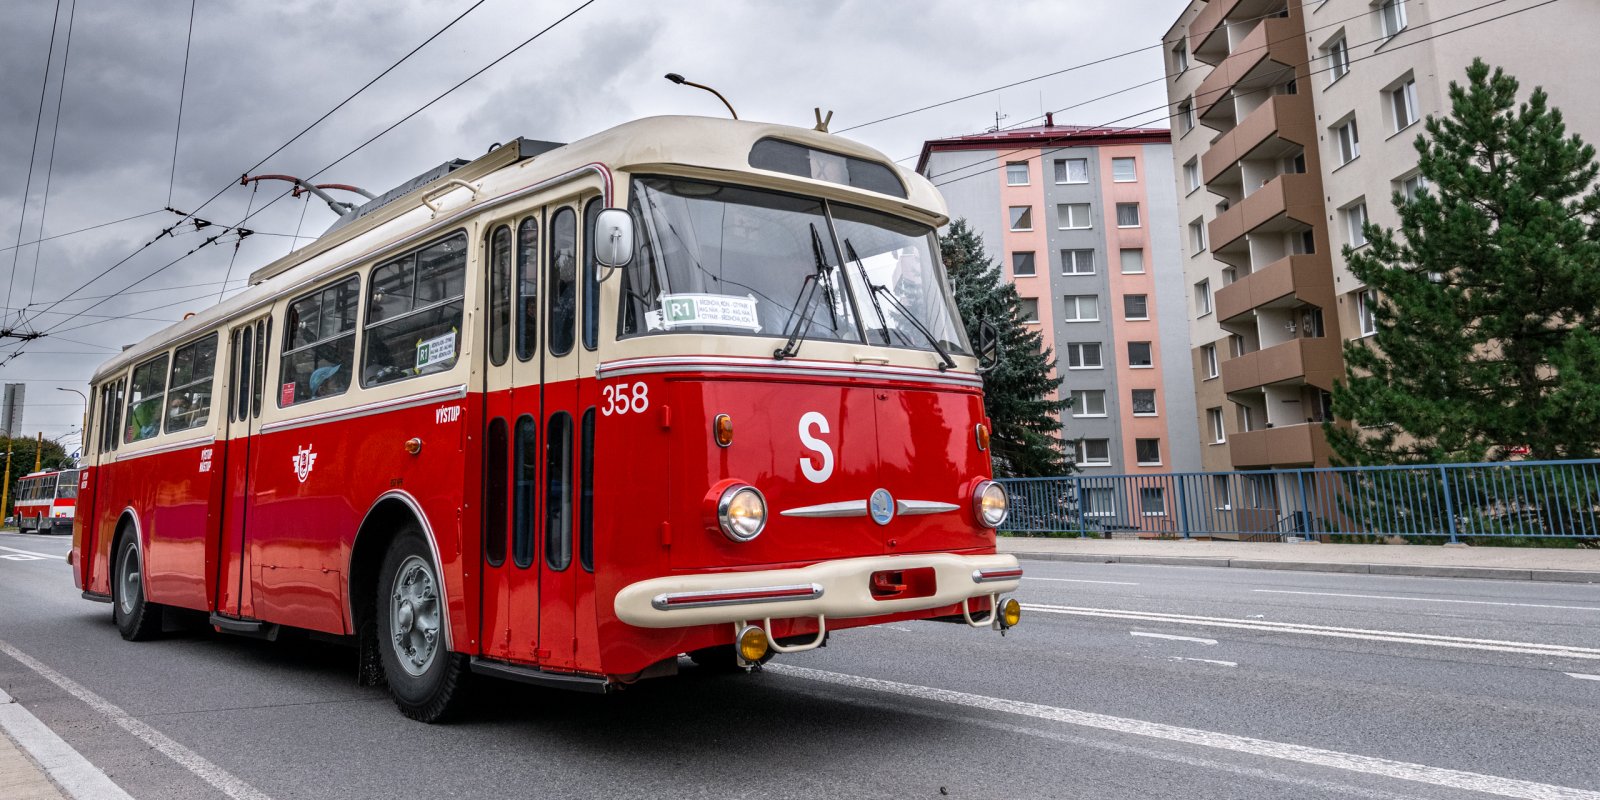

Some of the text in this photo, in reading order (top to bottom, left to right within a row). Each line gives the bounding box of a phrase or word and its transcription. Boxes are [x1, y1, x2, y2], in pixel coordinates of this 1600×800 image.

[672, 302, 690, 317] R1
[420, 347, 428, 361] R1
[601, 381, 649, 417] 358
[435, 404, 460, 425] VÝSTUP
[798, 411, 835, 484] S
